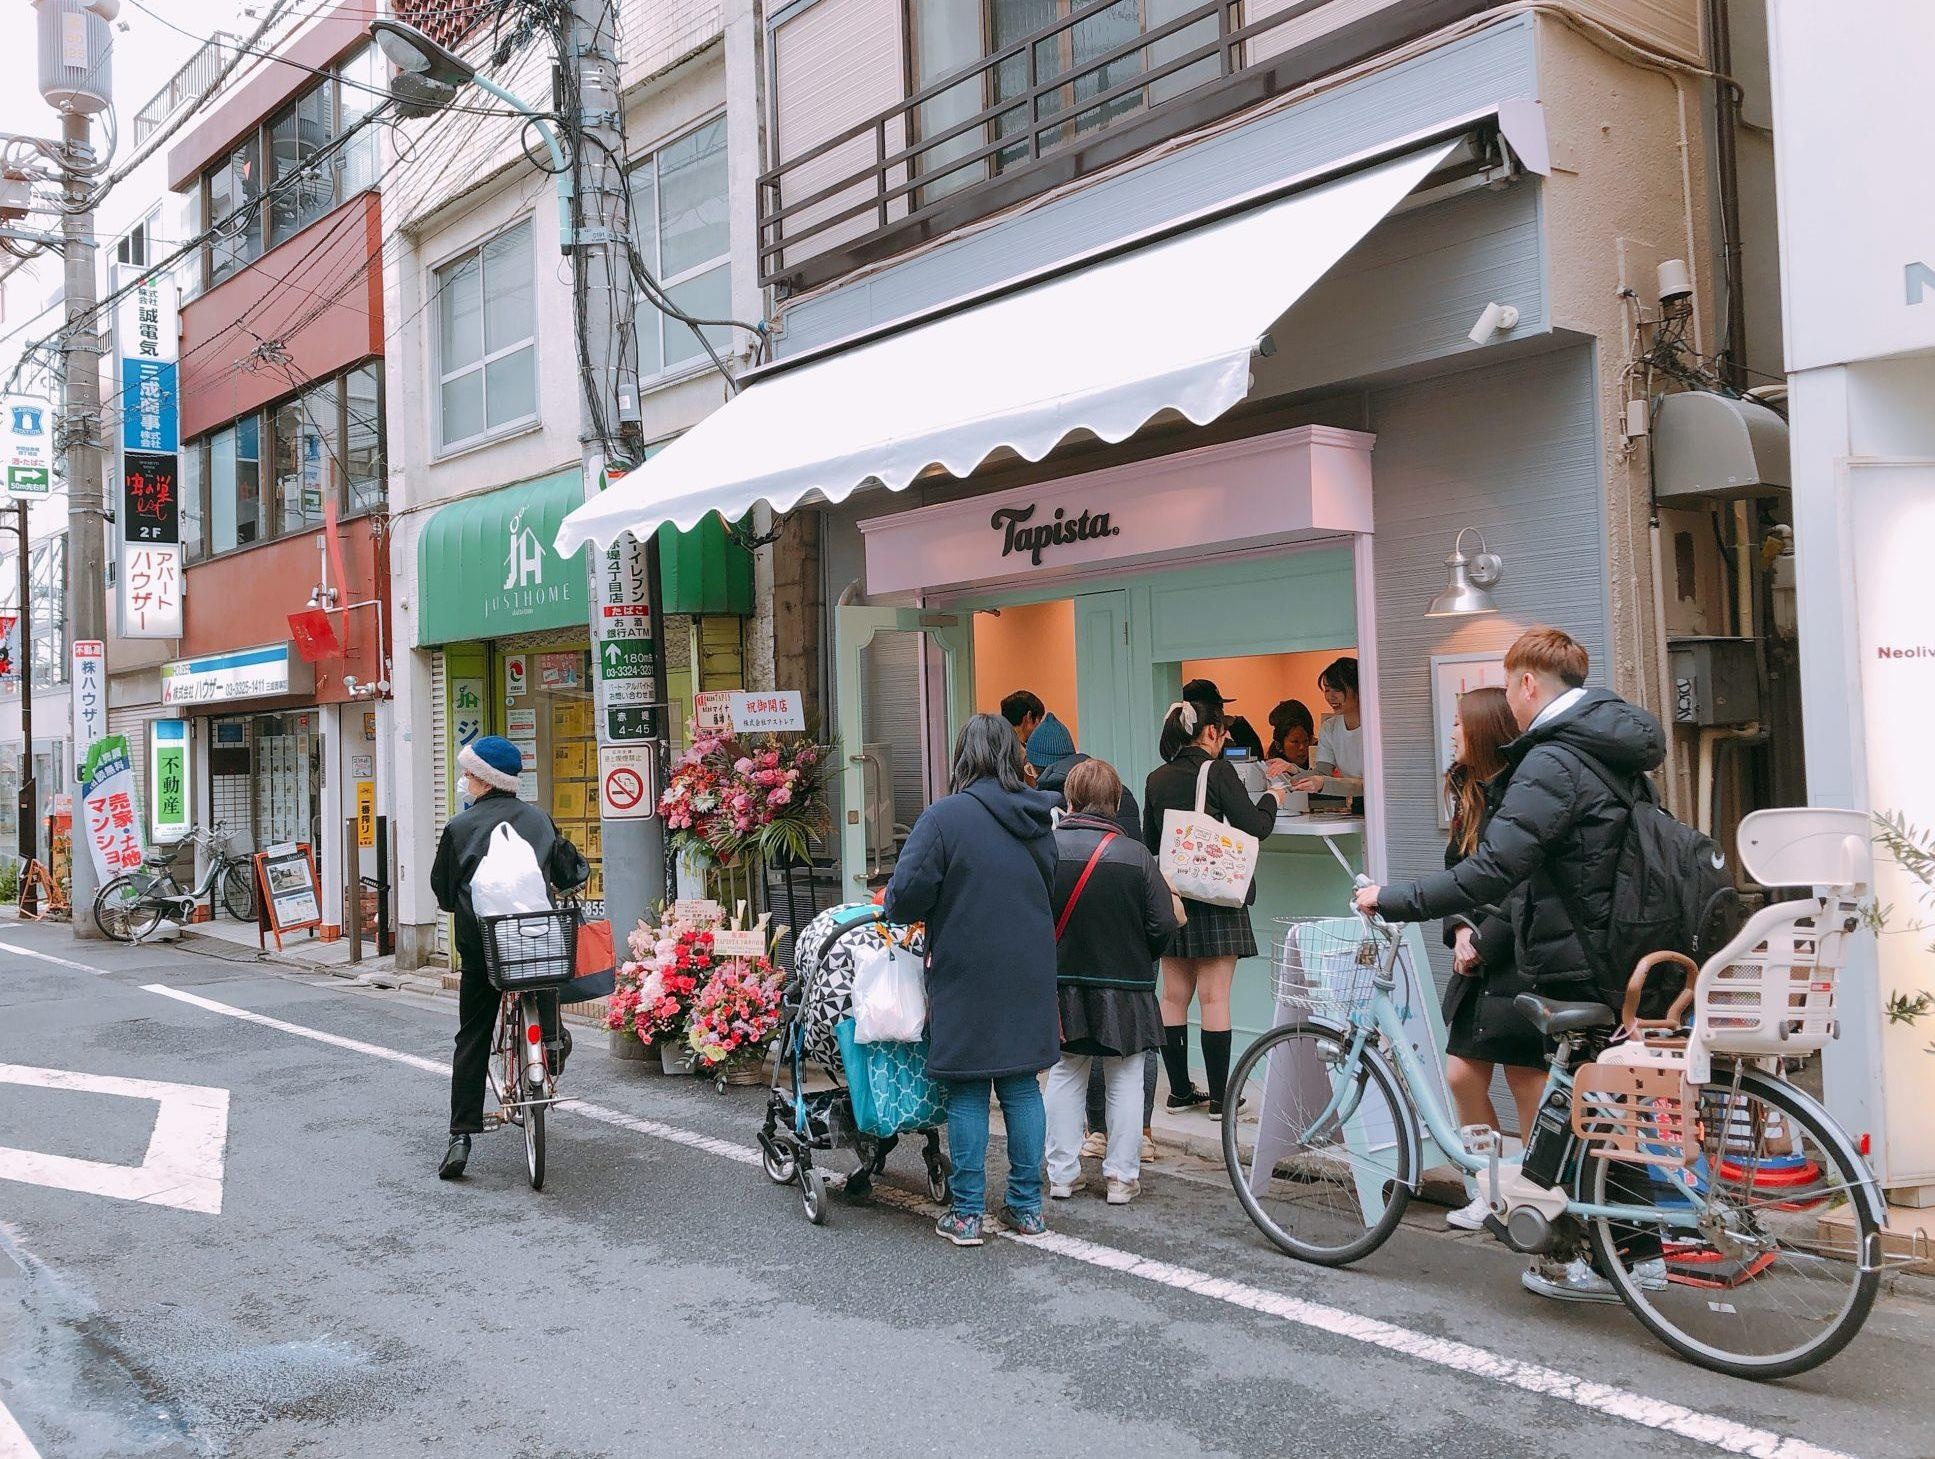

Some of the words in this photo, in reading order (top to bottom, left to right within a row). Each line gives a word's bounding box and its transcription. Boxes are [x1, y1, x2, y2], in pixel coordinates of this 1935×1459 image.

[139, 306, 159, 357] 誠電気
[139, 527, 162, 538] 2F
[991, 504, 1111, 566] Tapista
[131, 552, 153, 630] ハウザー
[157, 552, 174, 610] アパート
[611, 606, 645, 616] たばこ
[618, 724, 650, 735] 4-45
[161, 755, 180, 815] 不動産
[109, 793, 143, 868] 売家・土地
